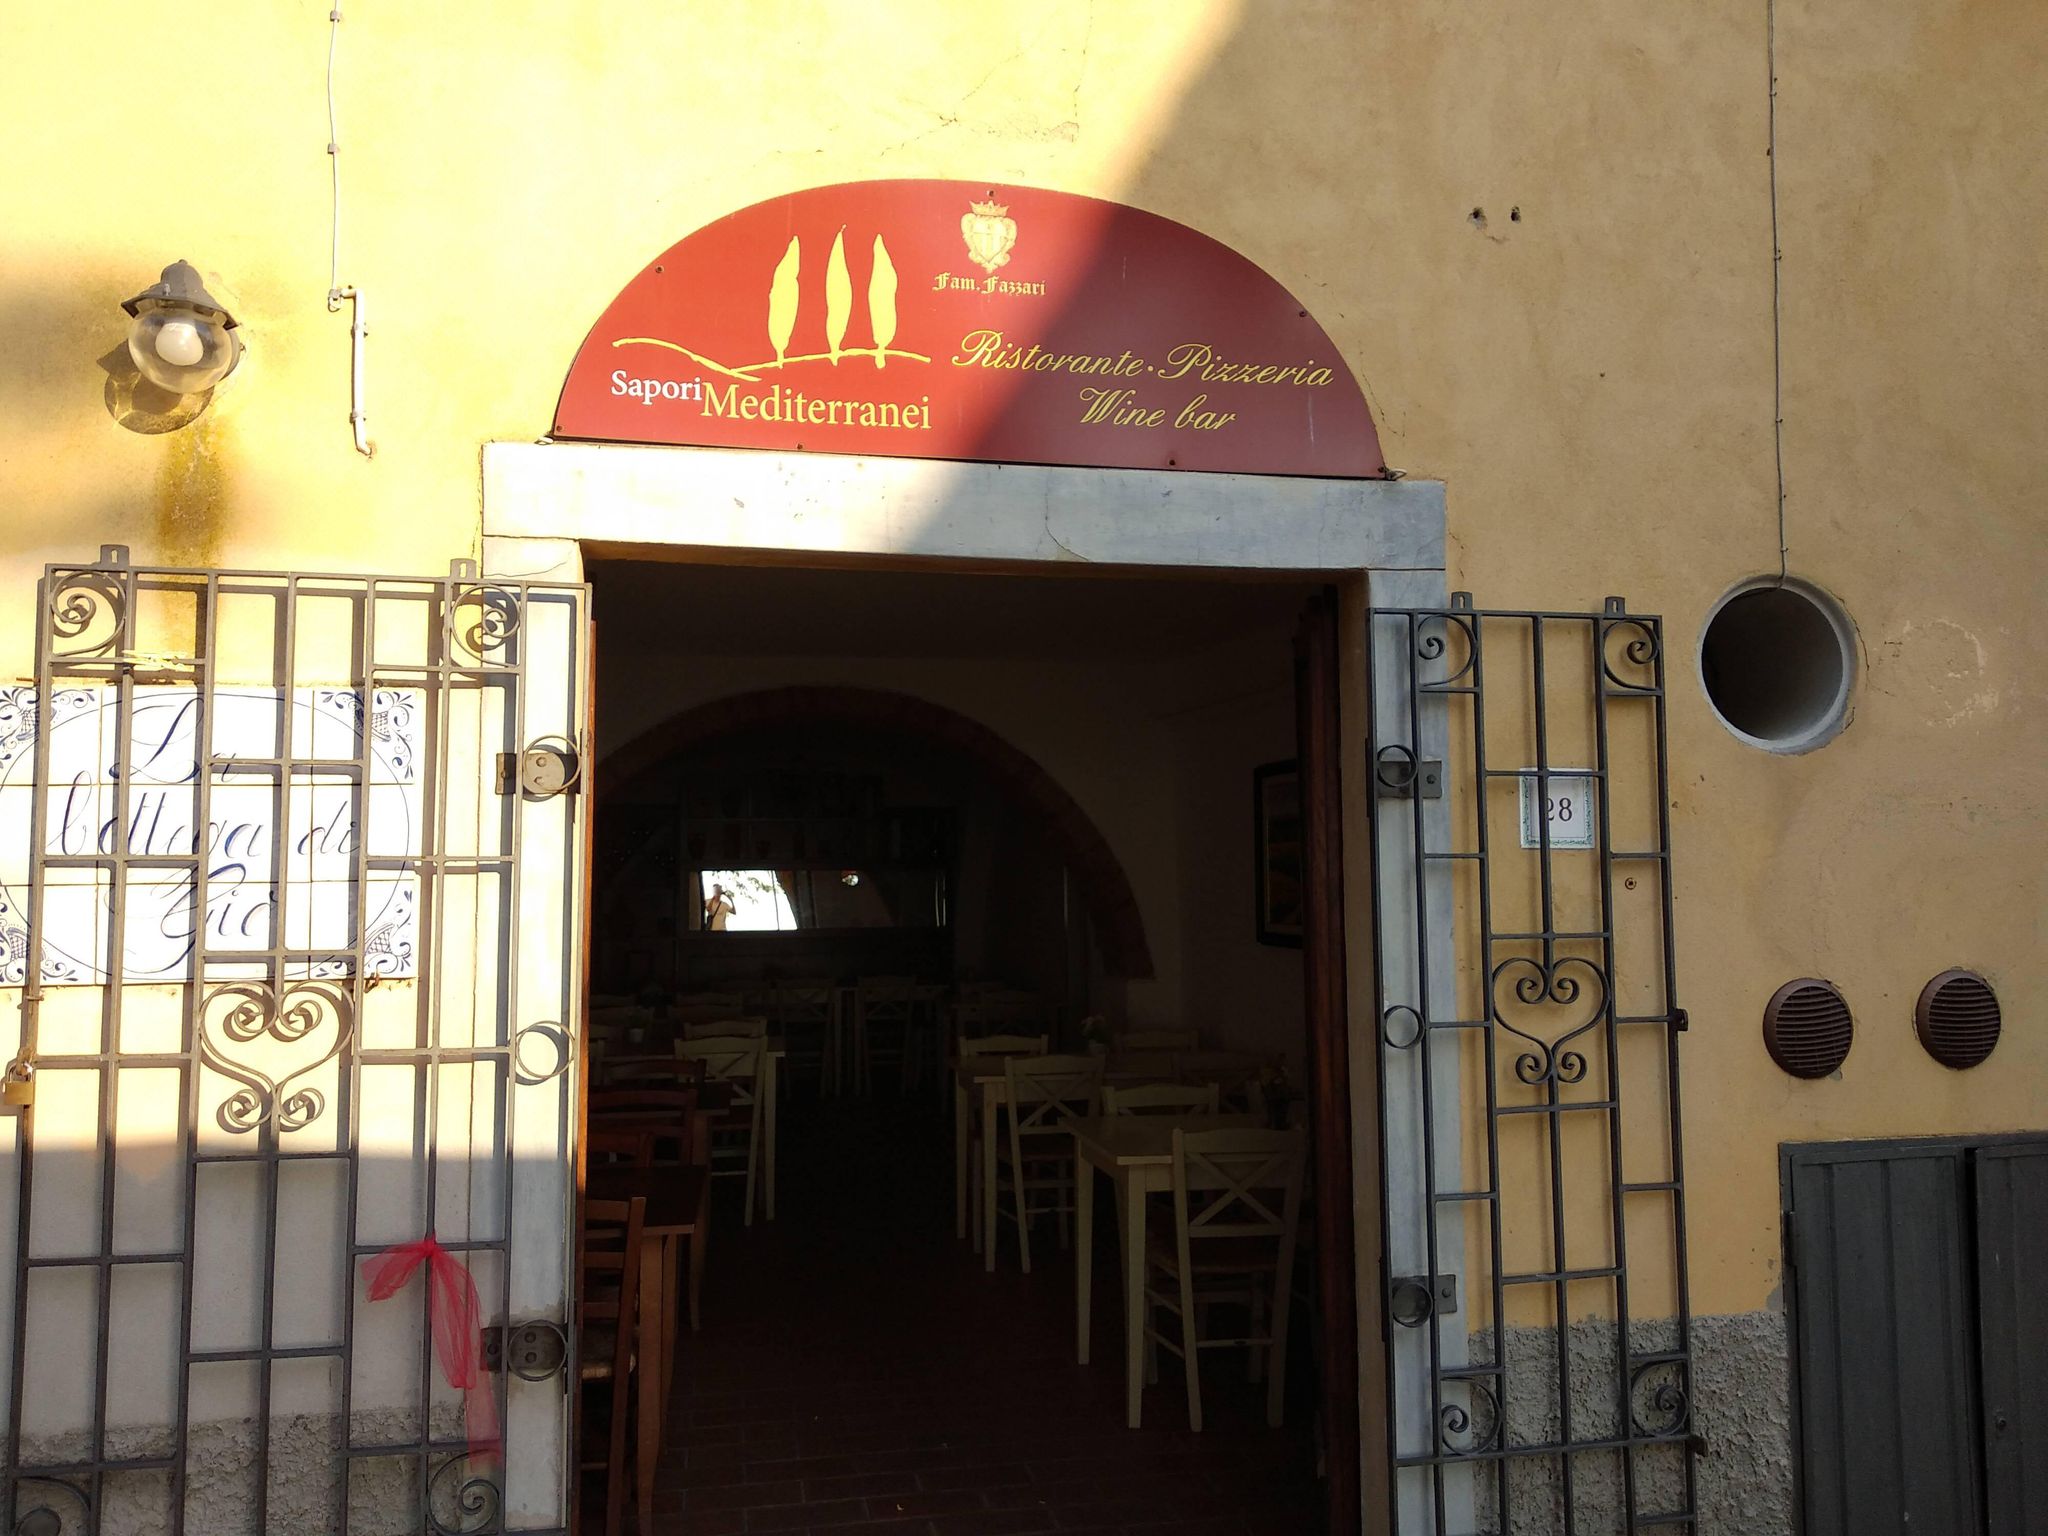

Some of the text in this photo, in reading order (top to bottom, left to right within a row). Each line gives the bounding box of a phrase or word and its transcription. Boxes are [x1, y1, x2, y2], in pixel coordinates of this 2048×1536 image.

[932, 272, 1046, 296] Fam. Fazzari
[951, 329, 1334, 387] Ristorante Pizzeria
[611, 370, 932, 430] Sapori Mediterranei
[1079, 387, 1236, 430] Wine bar
[297, 800, 361, 856] di
